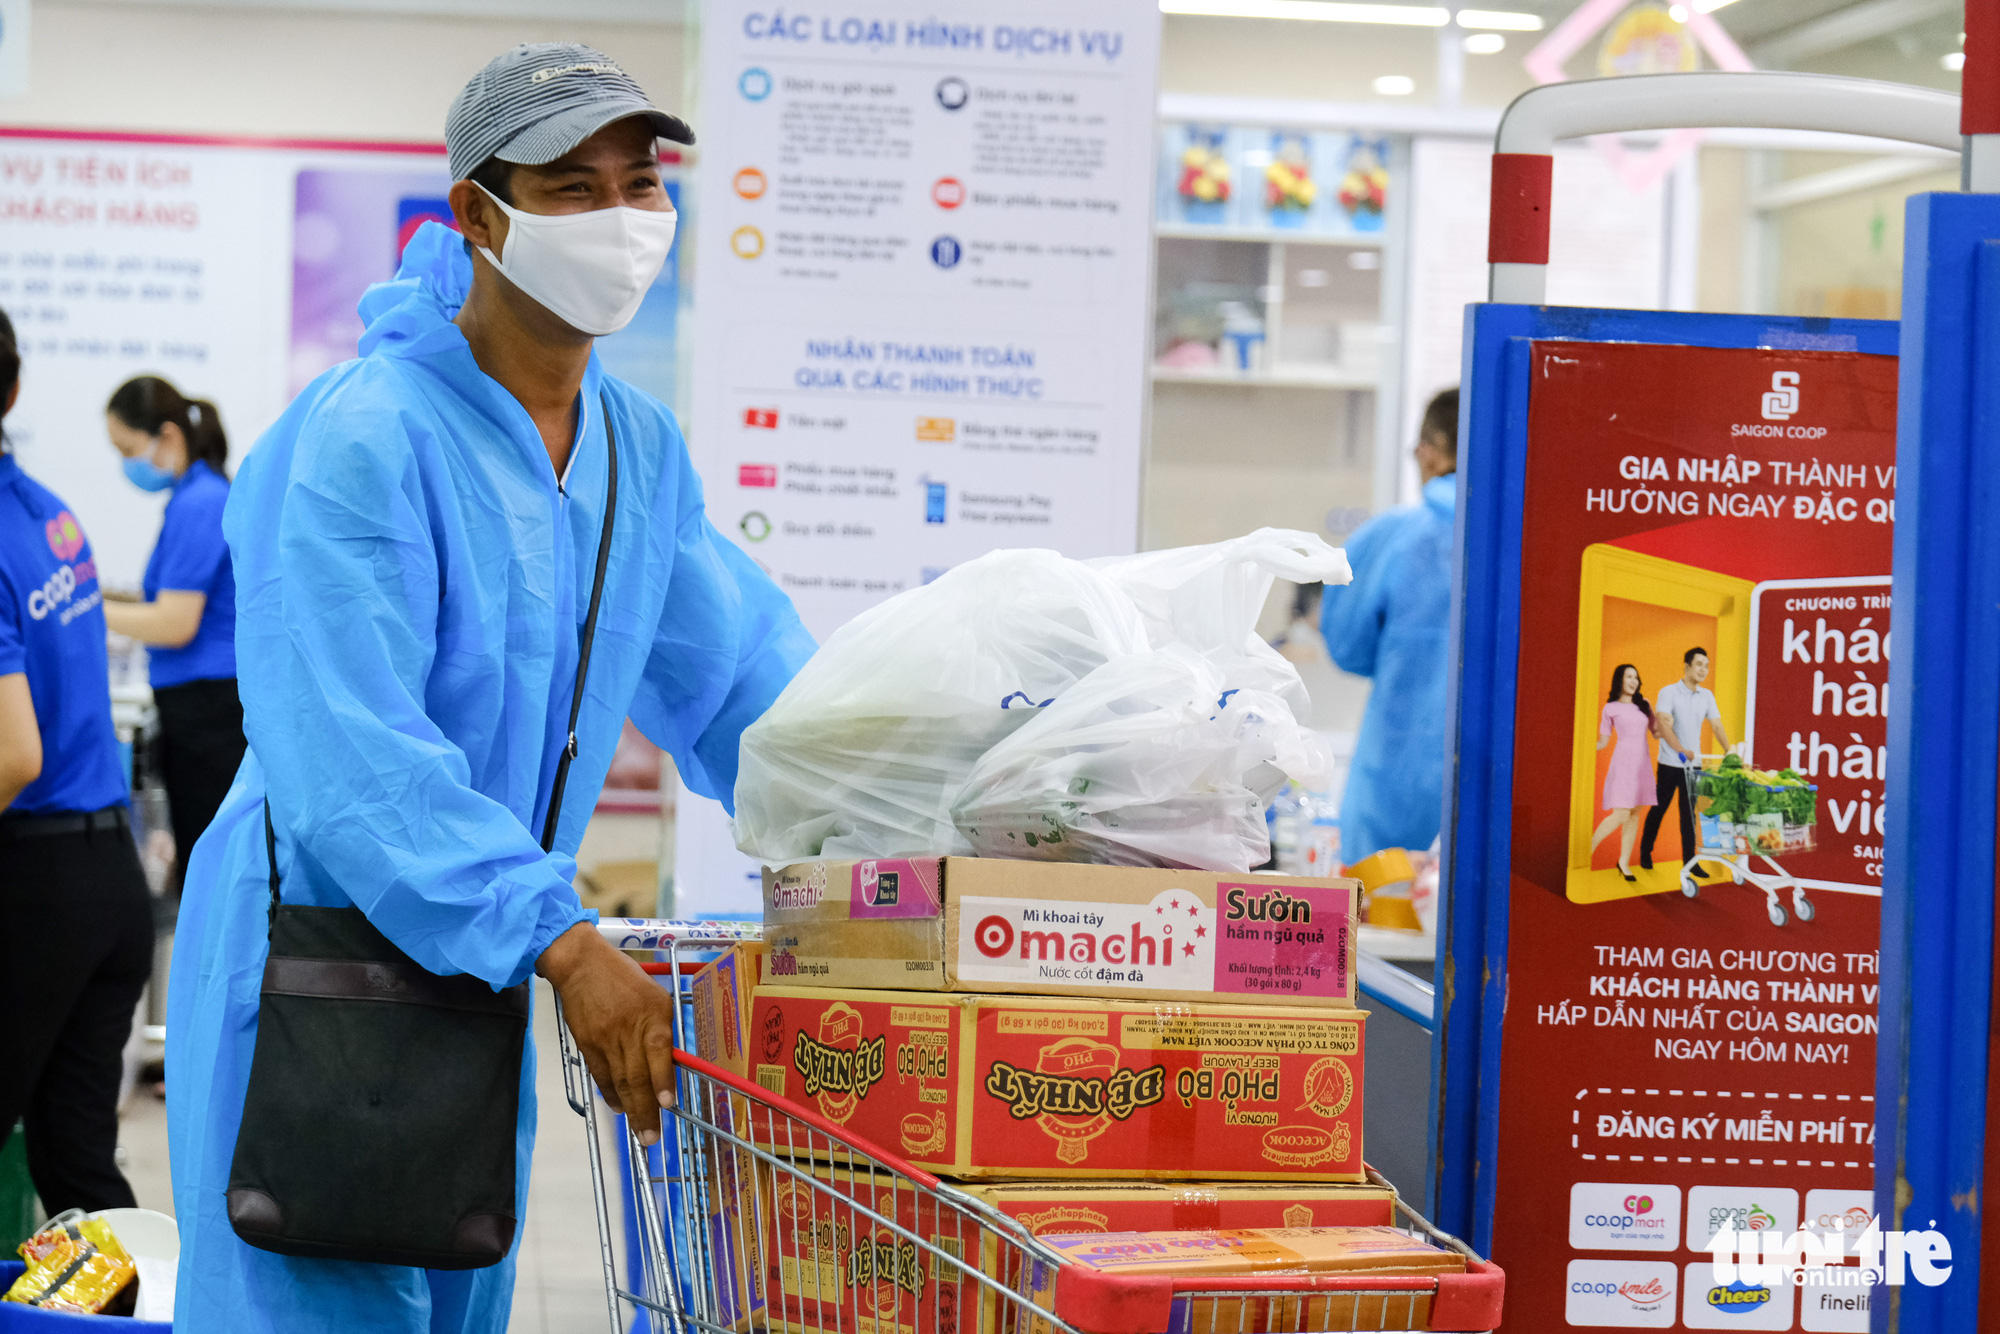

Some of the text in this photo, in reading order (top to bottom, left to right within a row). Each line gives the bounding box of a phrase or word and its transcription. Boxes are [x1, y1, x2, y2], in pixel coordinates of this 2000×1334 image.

[742, 12, 1123, 60] CÁC LOẠI HÌNH DỊCH VỤ
[1731, 424, 1783, 438] SAIGON
[1619, 455, 1669, 481] GIA
[1678, 453, 1760, 487] NHẬP
[1768, 457, 1866, 488] THÀNH
[1587, 483, 1699, 515] HƯỞNG
[1708, 492, 1786, 518] NGAY
[1793, 490, 1857, 525] ĐẶC
[1785, 596, 1857, 611] CHƯƠNG
[772, 878, 818, 911] Omachi
[1226, 888, 1311, 923] Sườn
[1023, 909, 1104, 928] Mì khoai tây
[974, 915, 1173, 967] Omachi
[1227, 923, 1324, 945] hầm ngũ quả
[1229, 962, 1321, 979] Khối lượng tịnh: 2,4 kg
[1594, 945, 1664, 968] THAM
[1671, 947, 1713, 970] GIA
[1719, 949, 1836, 973] CHƯƠNG
[1039, 965, 1144, 983] Nước cốt đậm đà
[1245, 977, 1258, 988] (30
[1261, 977, 1273, 990] gói
[1281, 979, 1292, 989] 80
[1293, 979, 1302, 992] g)
[1590, 972, 1680, 999] KHÁCH
[1687, 974, 1760, 1002] HÀNG
[1766, 977, 1854, 1004] THÀNH
[1001, 1016, 1105, 1031] 2,040 kg (30 gói x 68 g)
[1537, 998, 1587, 1026] HẤP
[1594, 999, 1645, 1029] DẪN
[1653, 1003, 1720, 1030] NHẤT
[1726, 1006, 1779, 1033] CỦA
[1162, 1036, 1355, 1053] CÔNG TY CỔ PHẦN ACECOOK VIỆT NAM
[1655, 1037, 1849, 1064] NGAY HÔM NAY!
[794, 1029, 853, 1098] NHẤT
[852, 1034, 885, 1100] ĐỆ
[898, 1046, 947, 1087] PHỞ BÒ
[1204, 1057, 1279, 1067] BEEF FLAVOUR
[985, 1060, 1166, 1121] ĐỆ NHẤT
[1177, 1068, 1279, 1110] PHỞ BÒ
[1226, 1113, 1277, 1125] HƯƠNG VỊ
[1313, 1103, 1330, 1116] NAM
[1597, 1110, 1675, 1139] ĐĂNG
[1682, 1113, 1719, 1140] KÝ
[1725, 1110, 1793, 1142] MIỄN
[1800, 1116, 1846, 1144] PHÍ
[1262, 1150, 1331, 1166] Cook happiness
[1035, 1207, 1108, 1224] Cook happiness
[1610, 1232, 1624, 1240] bạn
[1651, 1232, 1665, 1240] nhà
[1706, 1286, 1770, 1305] Cheers
